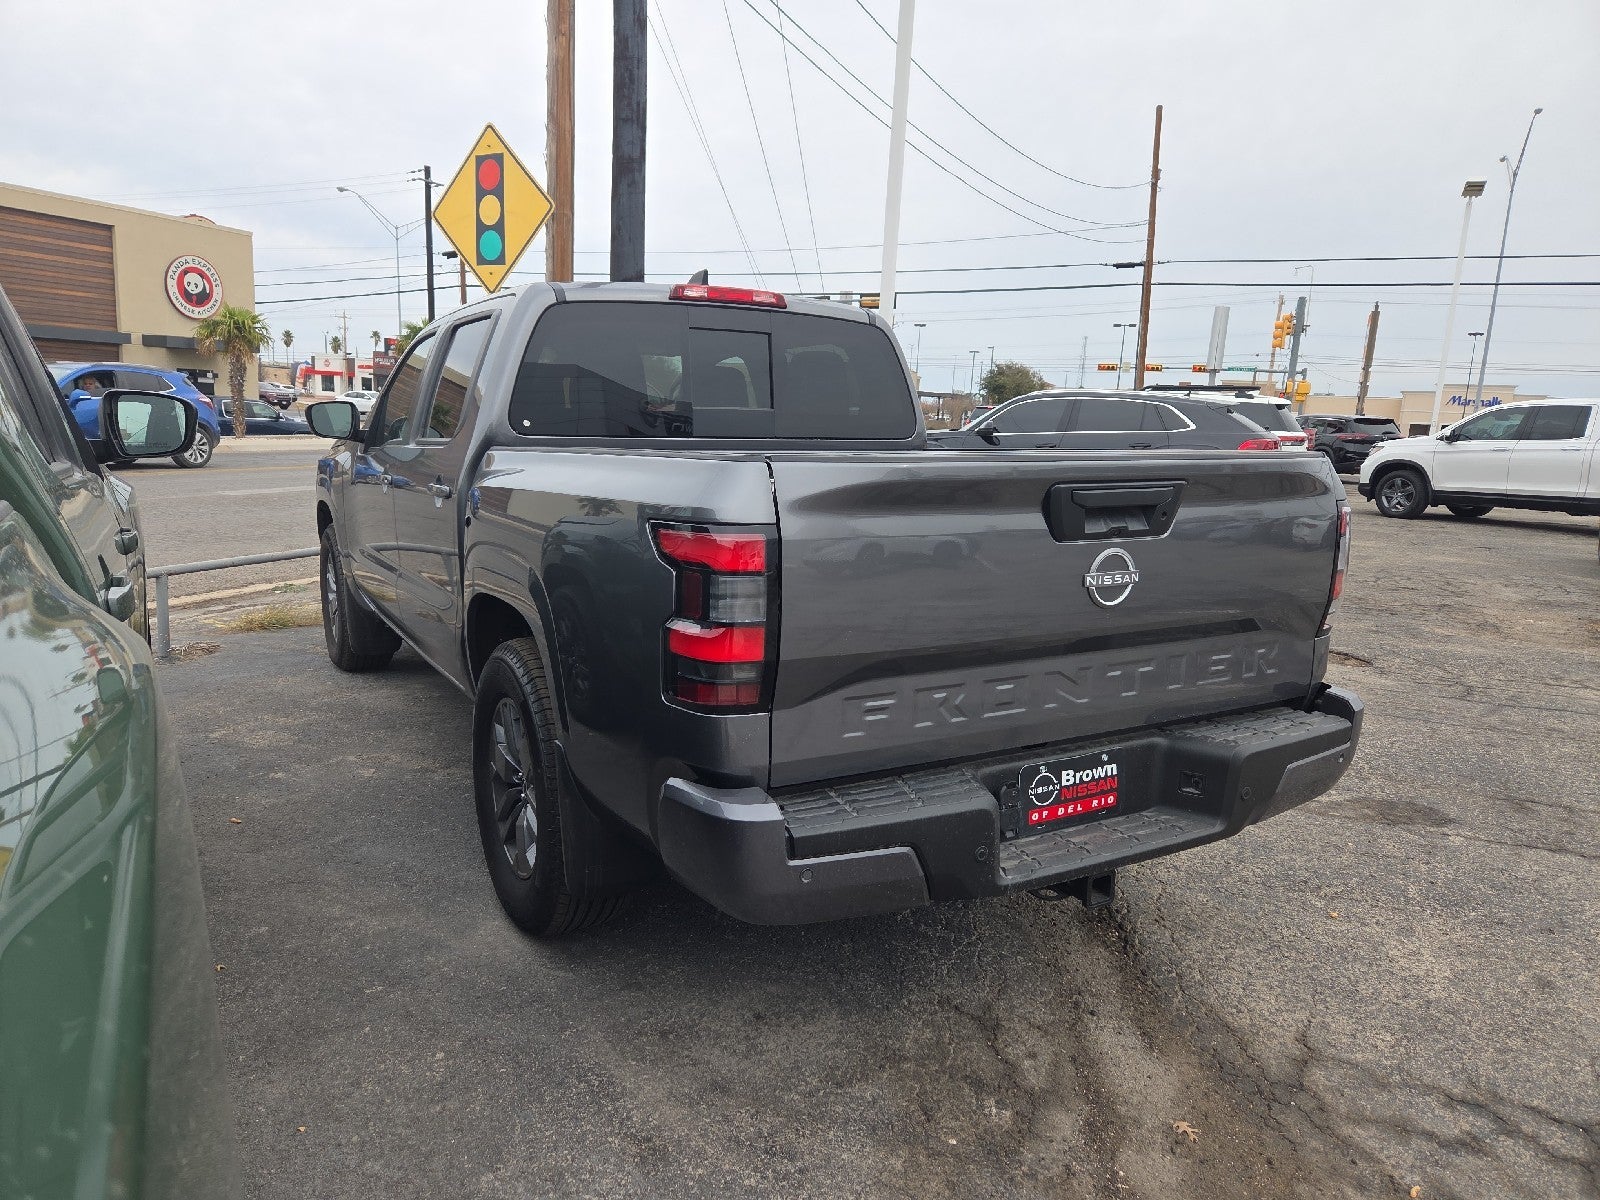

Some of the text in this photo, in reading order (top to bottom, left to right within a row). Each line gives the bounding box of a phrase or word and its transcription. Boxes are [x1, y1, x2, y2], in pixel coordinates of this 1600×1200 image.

[169, 258, 220, 288] PANDA EXPRESS
[172, 291, 219, 316] CHINESE KITCHEN
[1086, 572, 1139, 586] NISSAN
[842, 641, 1280, 739] FRONTIER
[1061, 763, 1118, 787] Brown
[1028, 783, 1060, 796] NISSAN
[1061, 776, 1118, 800] NISSAN
[1031, 795, 1115, 821] OF DEL RIO
